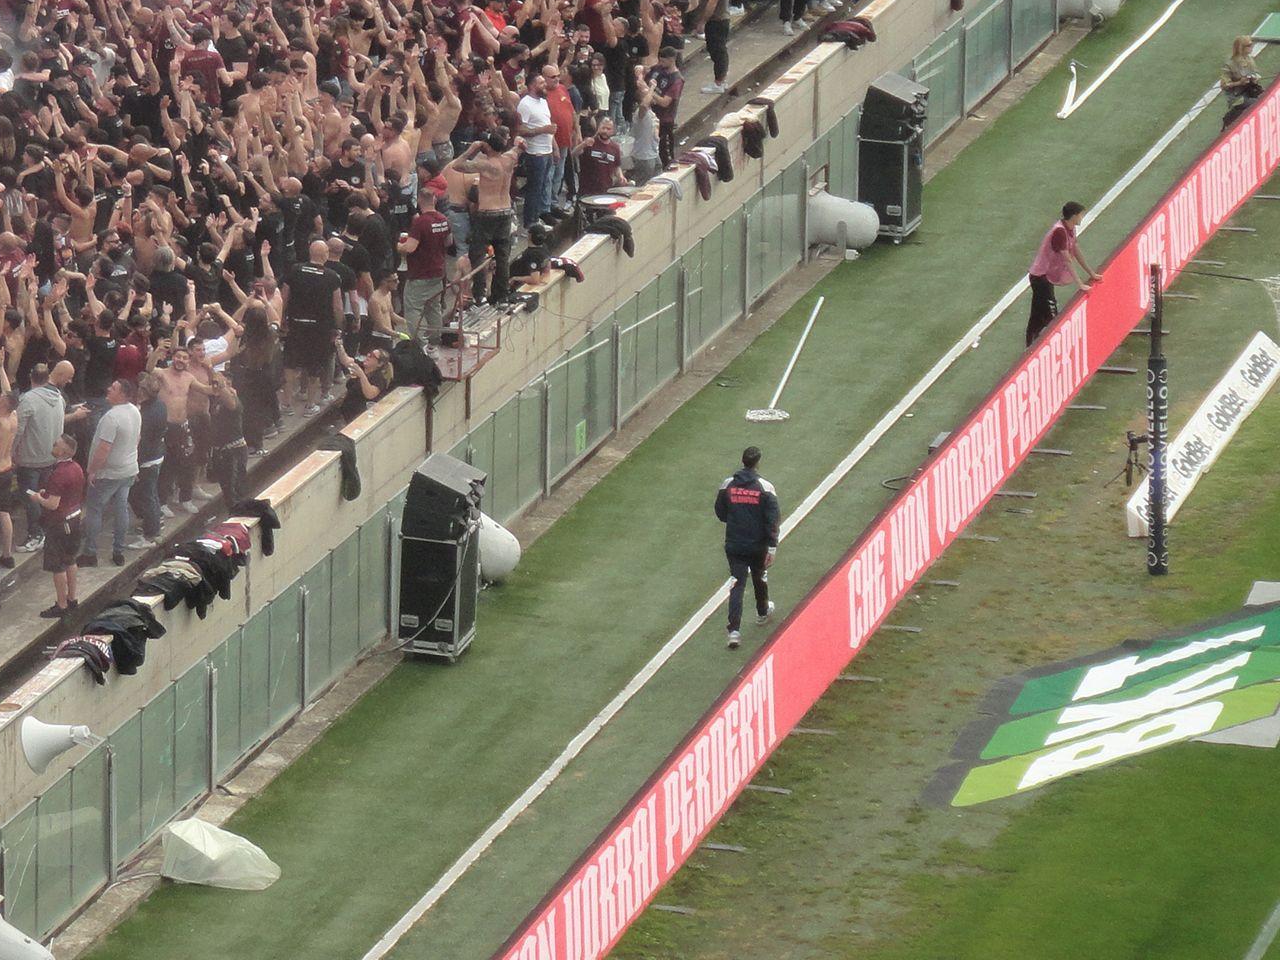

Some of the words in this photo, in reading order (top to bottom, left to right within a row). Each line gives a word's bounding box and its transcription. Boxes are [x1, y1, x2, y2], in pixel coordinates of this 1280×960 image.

[1168, 175, 1200, 276] NON
[1200, 115, 1258, 235] VORRAI
[847, 530, 886, 650] CHE
[888, 478, 930, 600] NON
[932, 393, 1002, 546] VORRAI
[1001, 304, 1090, 473] PERDERTI
[563, 793, 660, 960] VORRAI
[662, 653, 777, 874] PERDERTI
